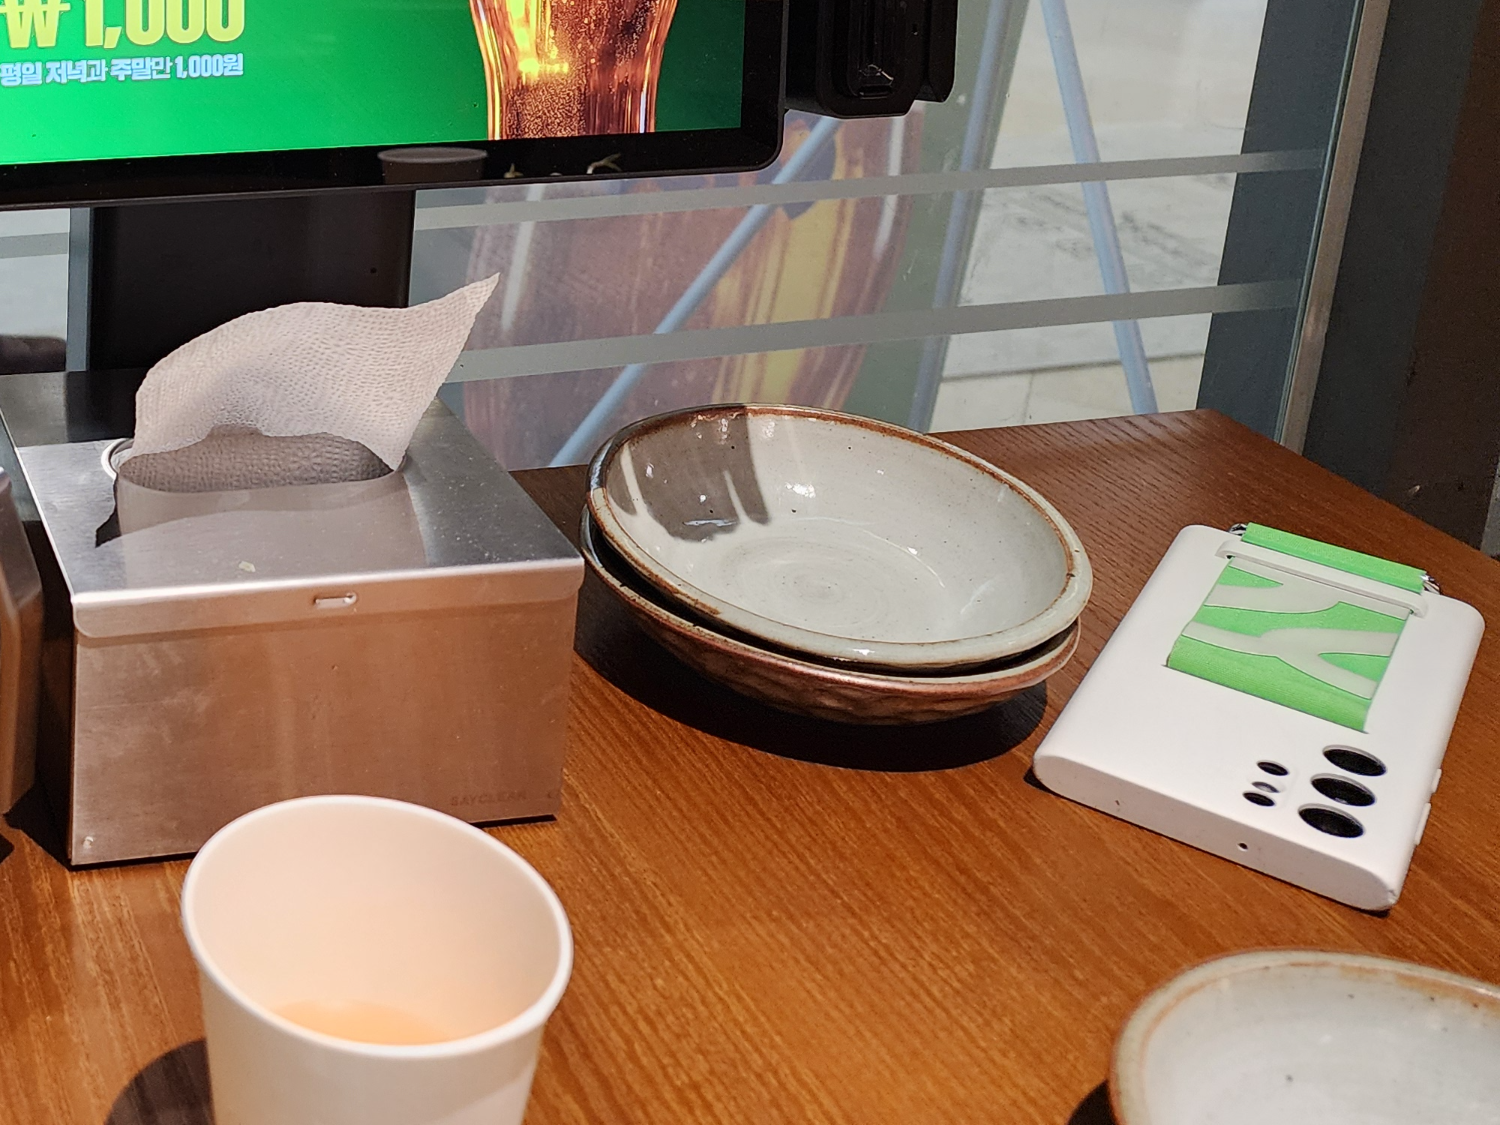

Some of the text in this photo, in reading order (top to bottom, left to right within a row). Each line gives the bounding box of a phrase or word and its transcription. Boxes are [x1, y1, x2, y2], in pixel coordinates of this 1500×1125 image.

[0, 53, 245, 87] 평일 저녁과 주말만 1,000원
